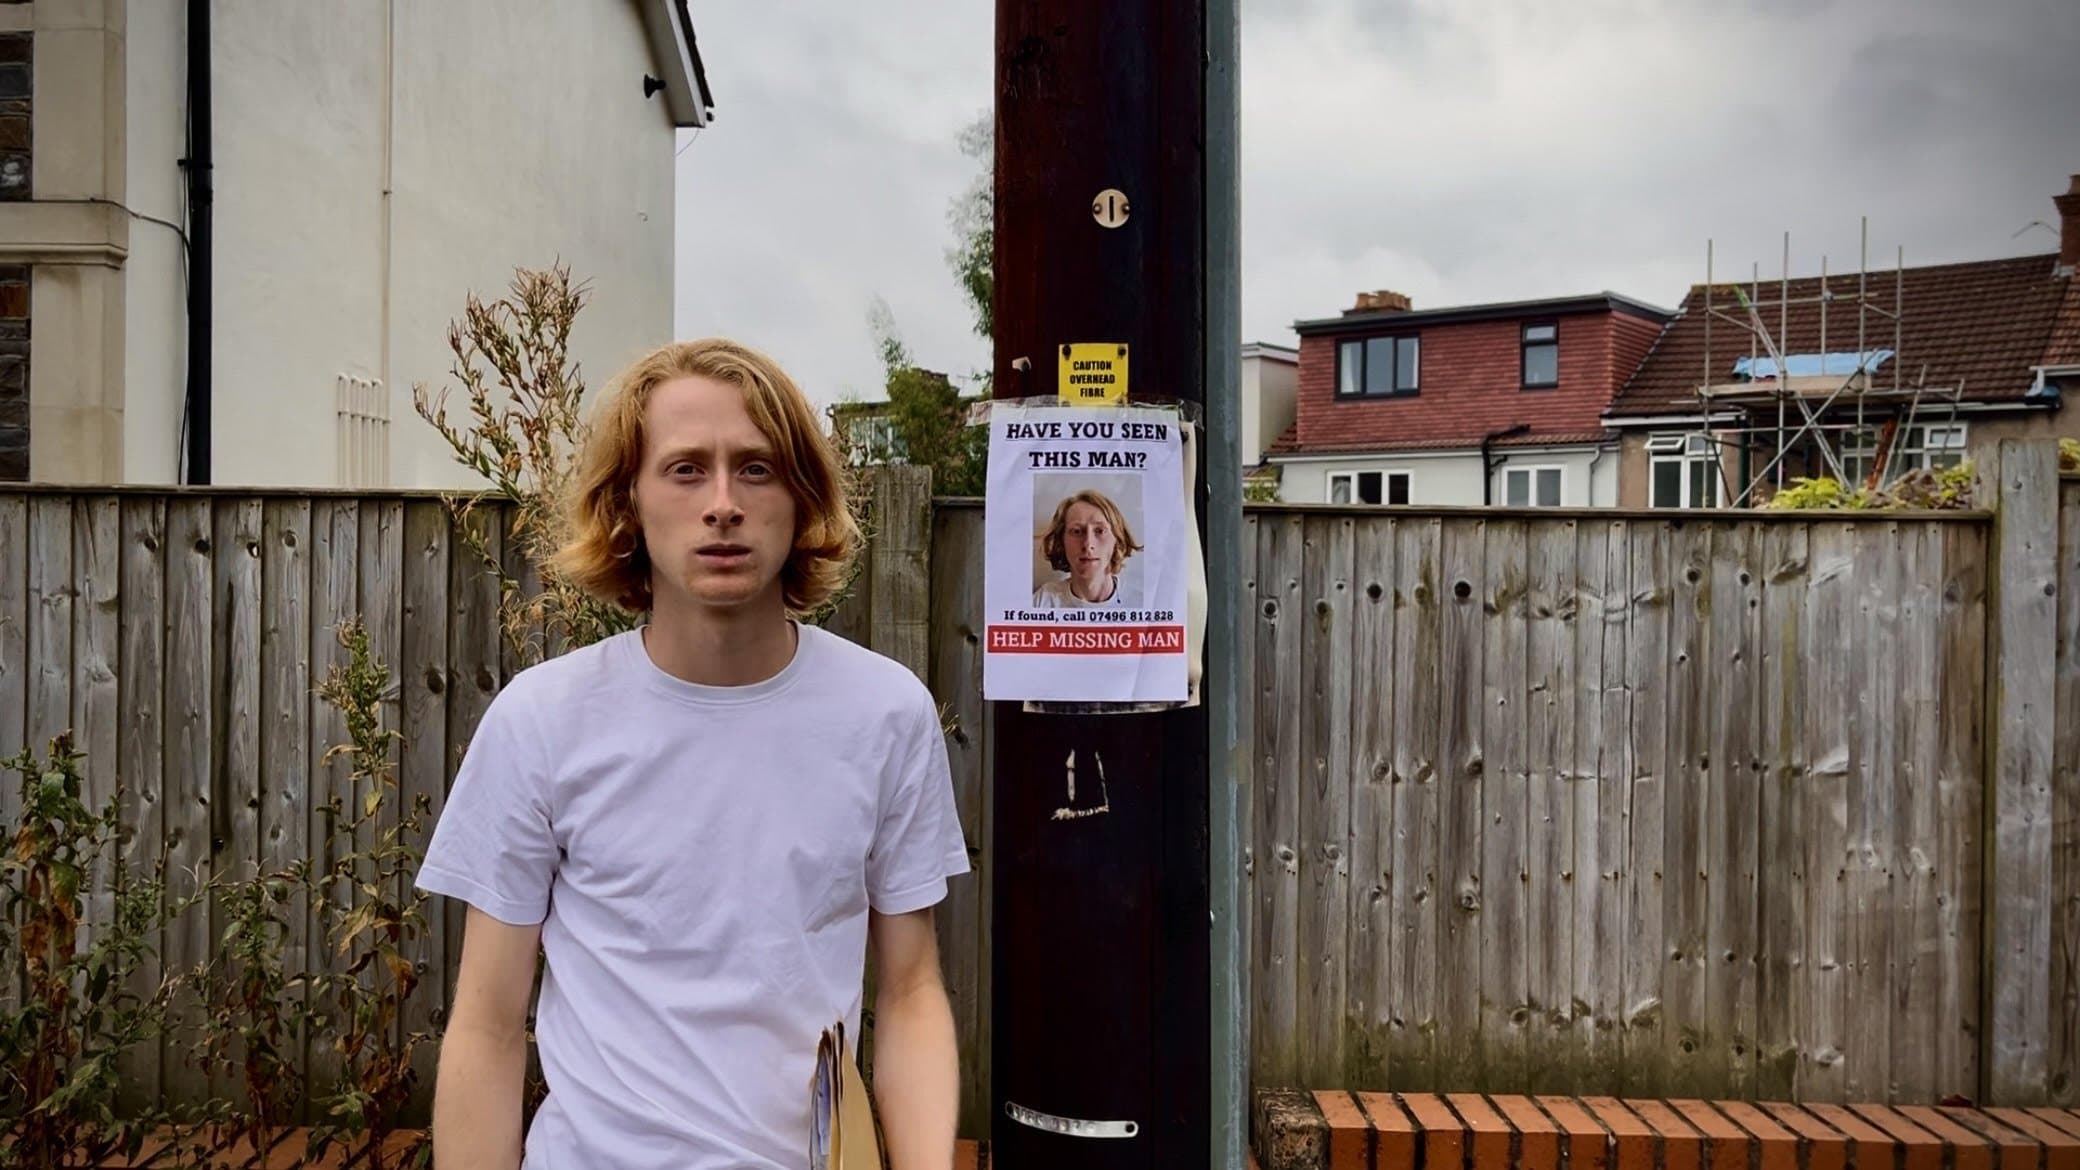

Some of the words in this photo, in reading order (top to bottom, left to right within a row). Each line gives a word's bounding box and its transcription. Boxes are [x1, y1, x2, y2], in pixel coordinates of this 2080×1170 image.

[1073, 361, 1112, 371] CAUTION
[1070, 375, 1115, 384] OVERHEAD
[1080, 388, 1105, 398] FIBRE
[1006, 423, 1062, 439] HAVE
[1068, 422, 1114, 439] YOU
[1121, 423, 1168, 440] SEEN
[1029, 451, 1080, 467] THIS
[1088, 452, 1147, 468] MAN?
[1004, 610, 1015, 620] If
[1018, 610, 1059, 623] found,
[1063, 611, 1085, 621] call
[1089, 611, 1126, 621] 07496
[1130, 611, 1151, 621] 812
[1154, 611, 1174, 621] 828
[992, 631, 1043, 647] HELP
[1049, 632, 1132, 648] MISSING
[1138, 631, 1180, 647] MAN
